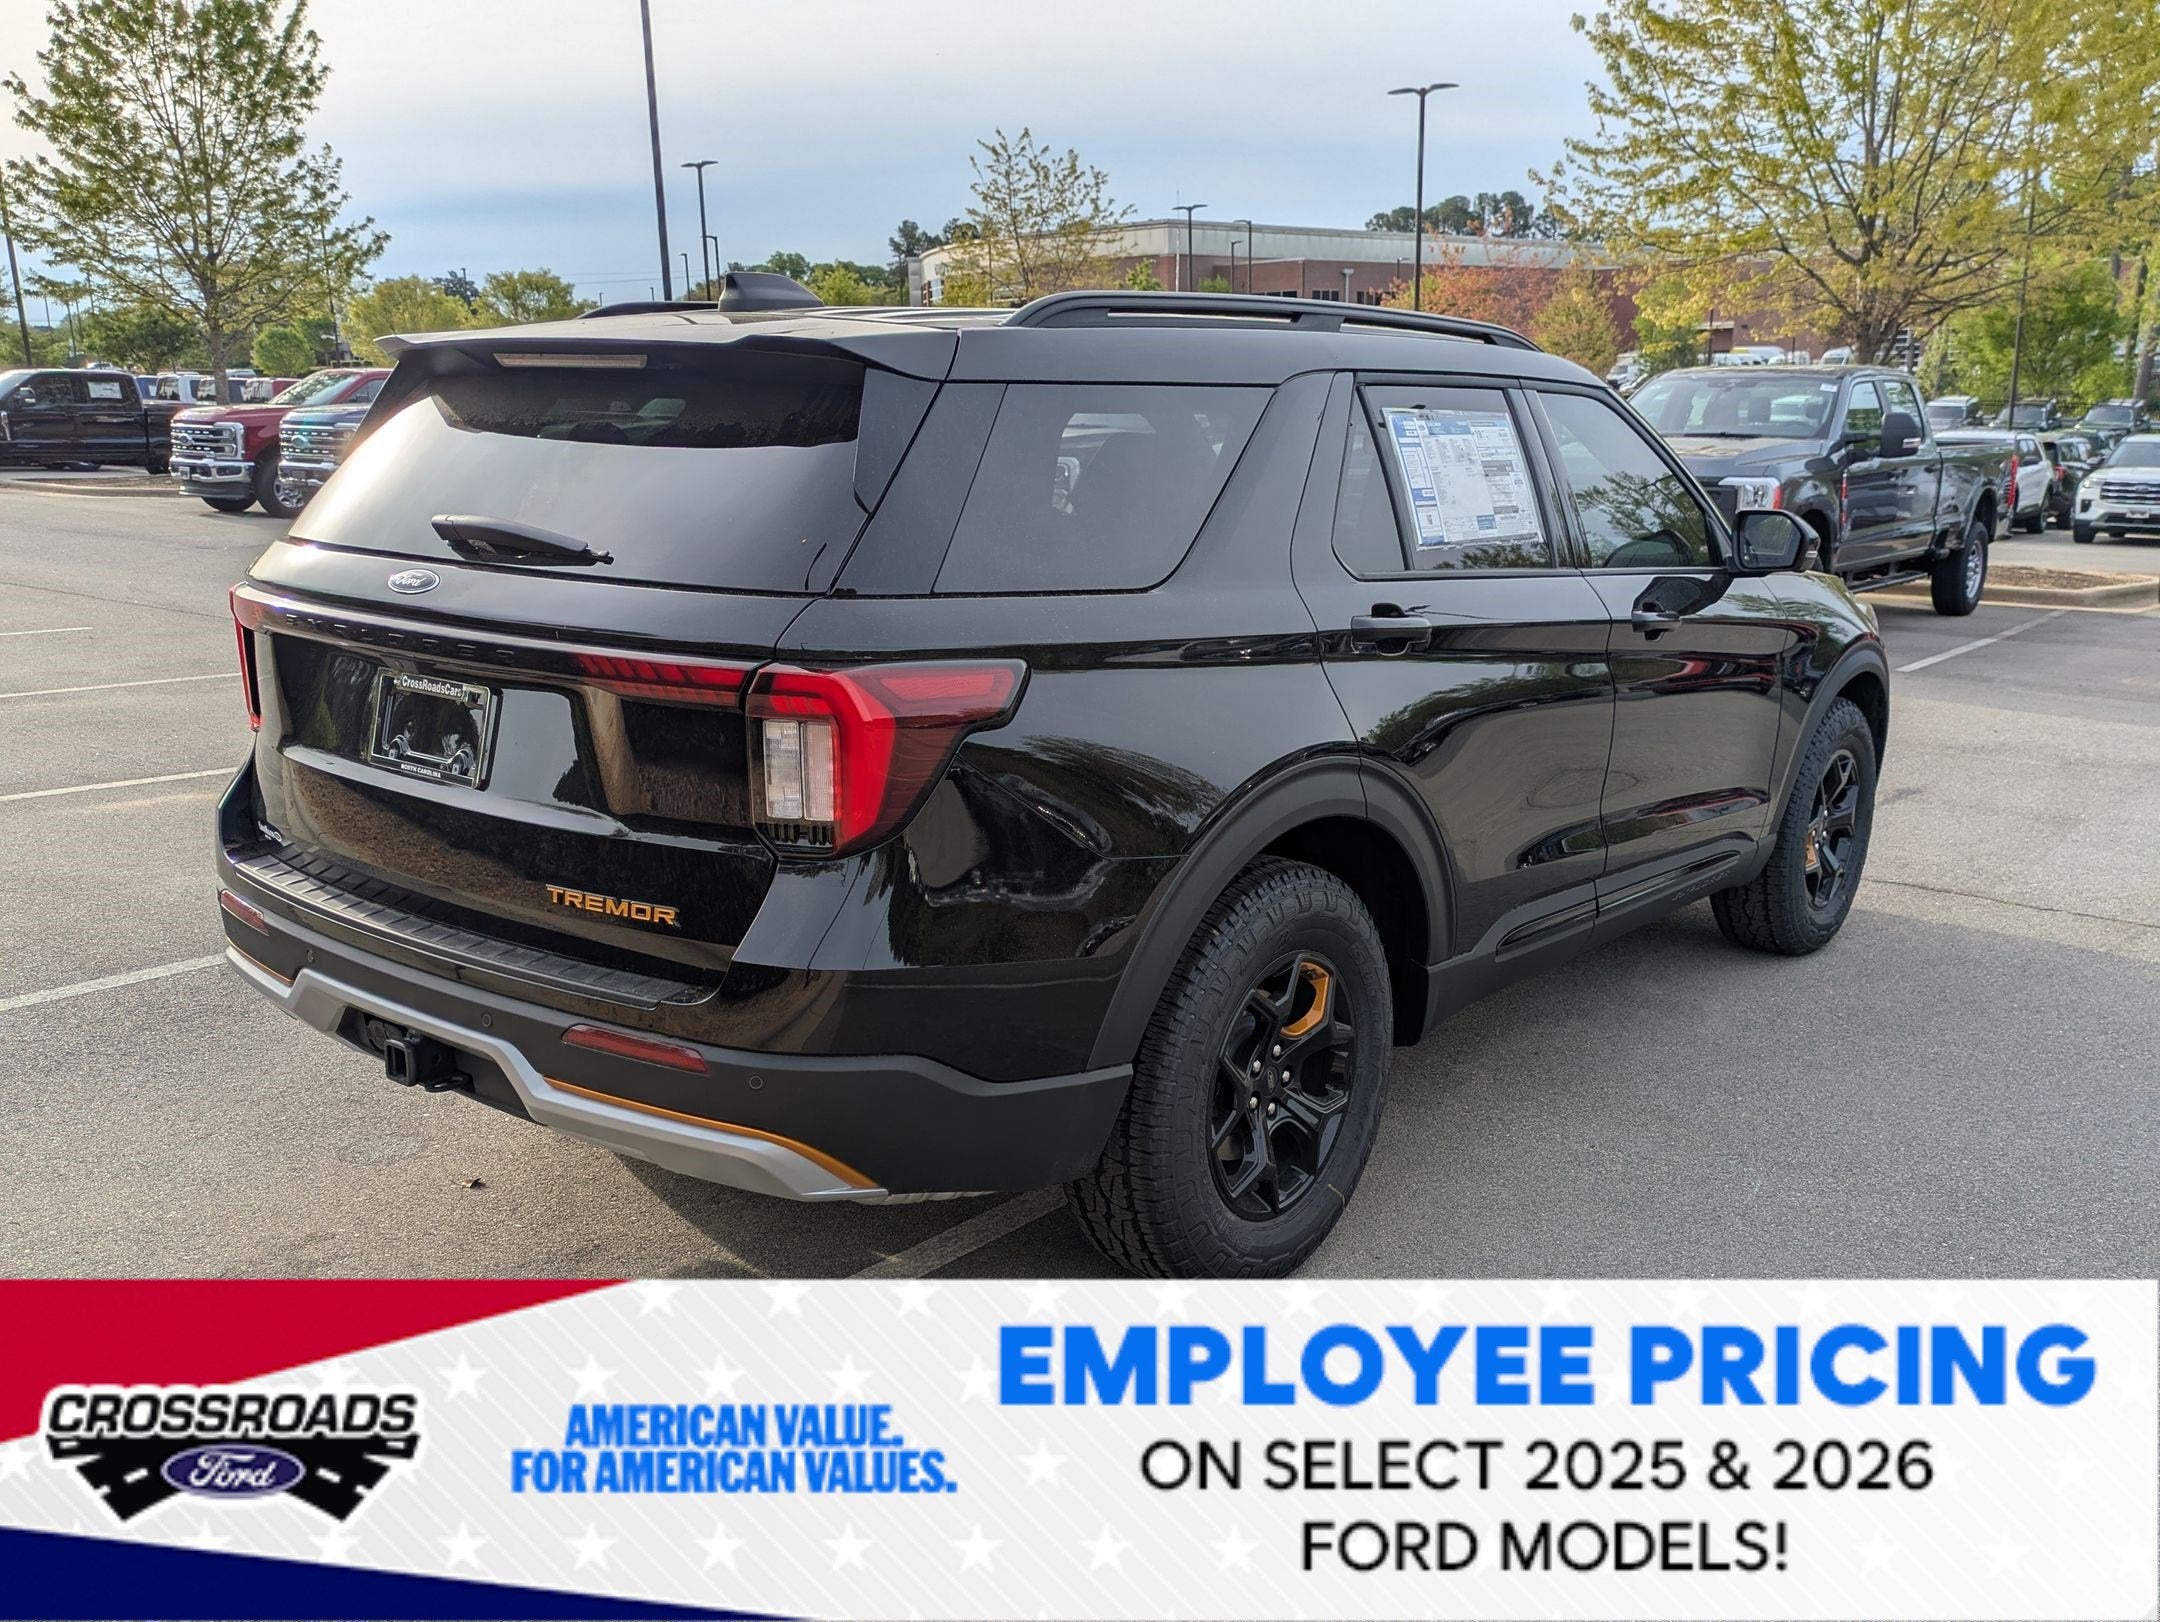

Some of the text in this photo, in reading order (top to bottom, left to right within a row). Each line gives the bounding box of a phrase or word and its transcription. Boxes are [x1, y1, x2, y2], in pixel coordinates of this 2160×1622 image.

[393, 571, 428, 587] Ford
[400, 763, 441, 778] NORTH CAROLINA
[545, 883, 681, 927] TREMOR
